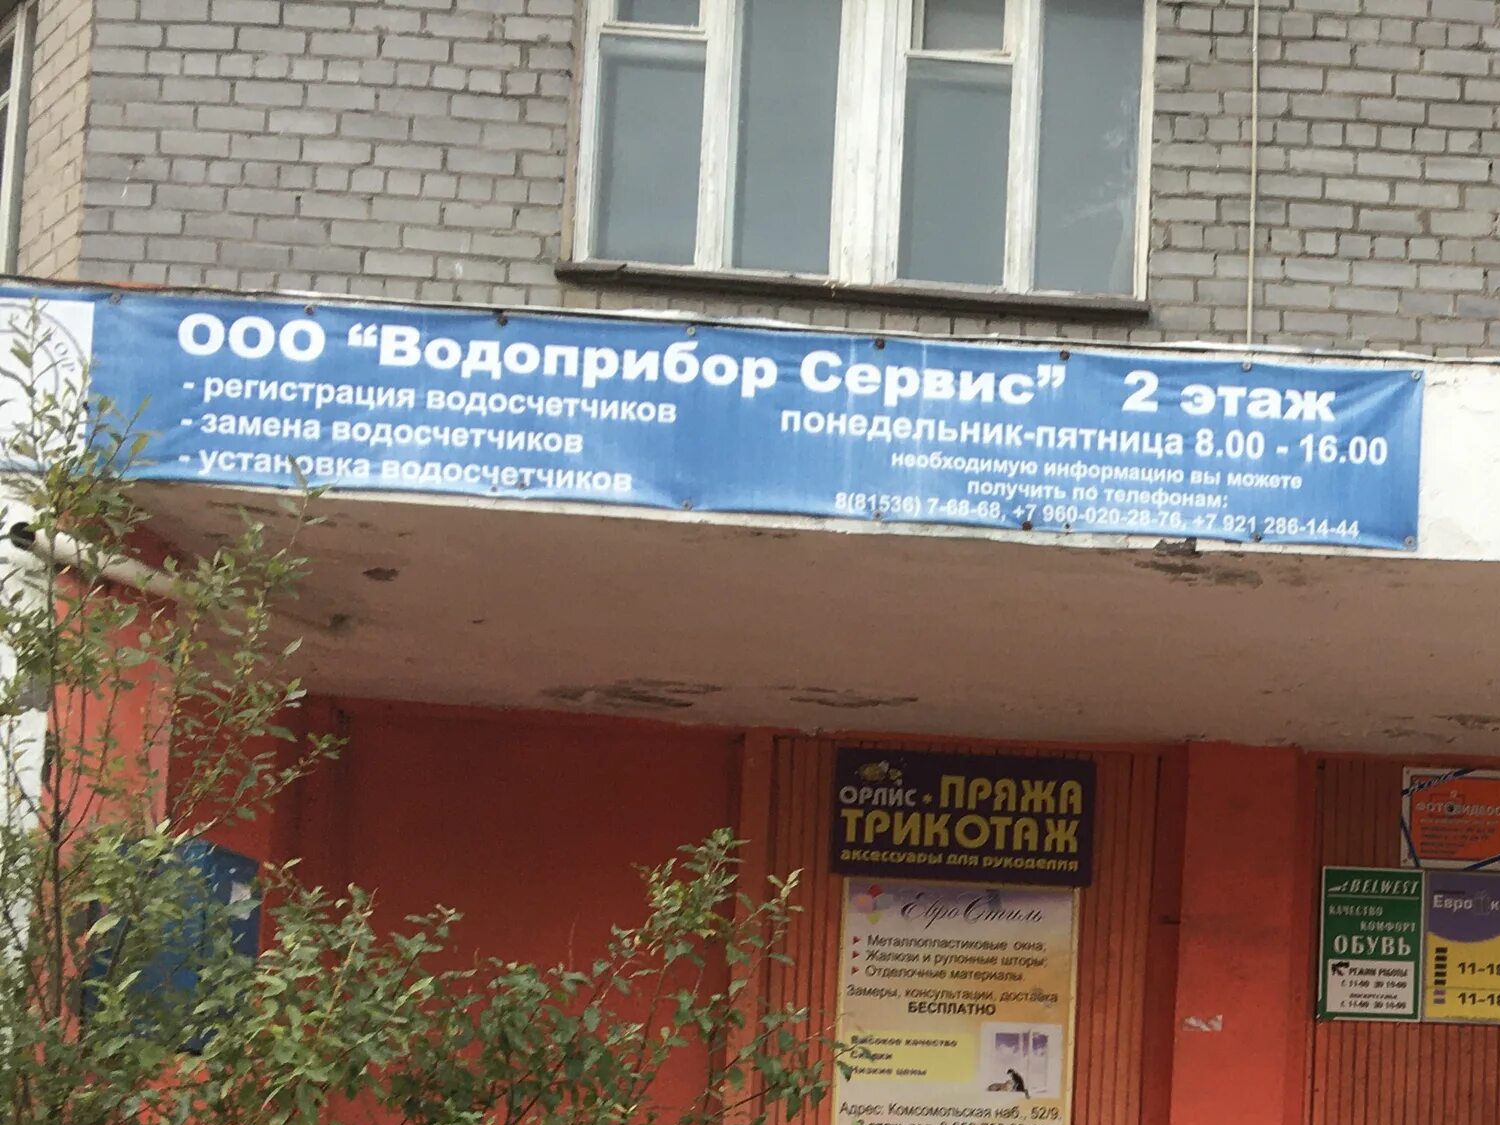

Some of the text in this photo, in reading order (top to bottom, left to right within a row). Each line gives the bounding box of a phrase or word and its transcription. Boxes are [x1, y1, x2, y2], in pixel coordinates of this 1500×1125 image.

[177, 312, 326, 362] ООО
[204, 375, 415, 409] регистрация
[425, 387, 677, 424] водосчетчиков
[1121, 369, 1336, 422] 2 этаж
[200, 413, 321, 440] замена
[332, 420, 583, 454] водосчетчиков
[781, 409, 1184, 459] понедельник-пятница
[1194, 427, 1265, 459] 8.00
[1300, 433, 1388, 466] 16.00
[199, 447, 371, 481] установка
[381, 459, 632, 494] водосчетчиков
[891, 450, 1302, 490] необходимую информацию вы можете
[967, 478, 1229, 509] получить по телефонам:
[835, 491, 921, 516] 8(81536)
[1223, 515, 1256, 534] 921
[1264, 517, 1360, 539] 286-14-44
[839, 774, 1084, 815] ОРЛИС ПРЯЖА
[840, 808, 1081, 854] ТРИКОТАЖ
[840, 849, 1079, 872] аксессуары для рукоделия
[1348, 878, 1420, 896] BELWEST
[1328, 904, 1384, 917] КАЧЕСТВО
[1359, 919, 1416, 933] КОМФОРТ
[866, 934, 1009, 951] Металлопластиковые
[1333, 934, 1412, 956] ОБУВЬ
[865, 950, 920, 963] Жалюзи
[921, 954, 931, 963] и
[934, 953, 998, 967] рулонные
[864, 965, 947, 980] Отделочные
[907, 1001, 997, 1016] БЕСПЛАТНО
[904, 1038, 958, 1048] качество
[839, 1101, 883, 1117] Адрес:
[887, 1103, 992, 1119] Комсомольская
